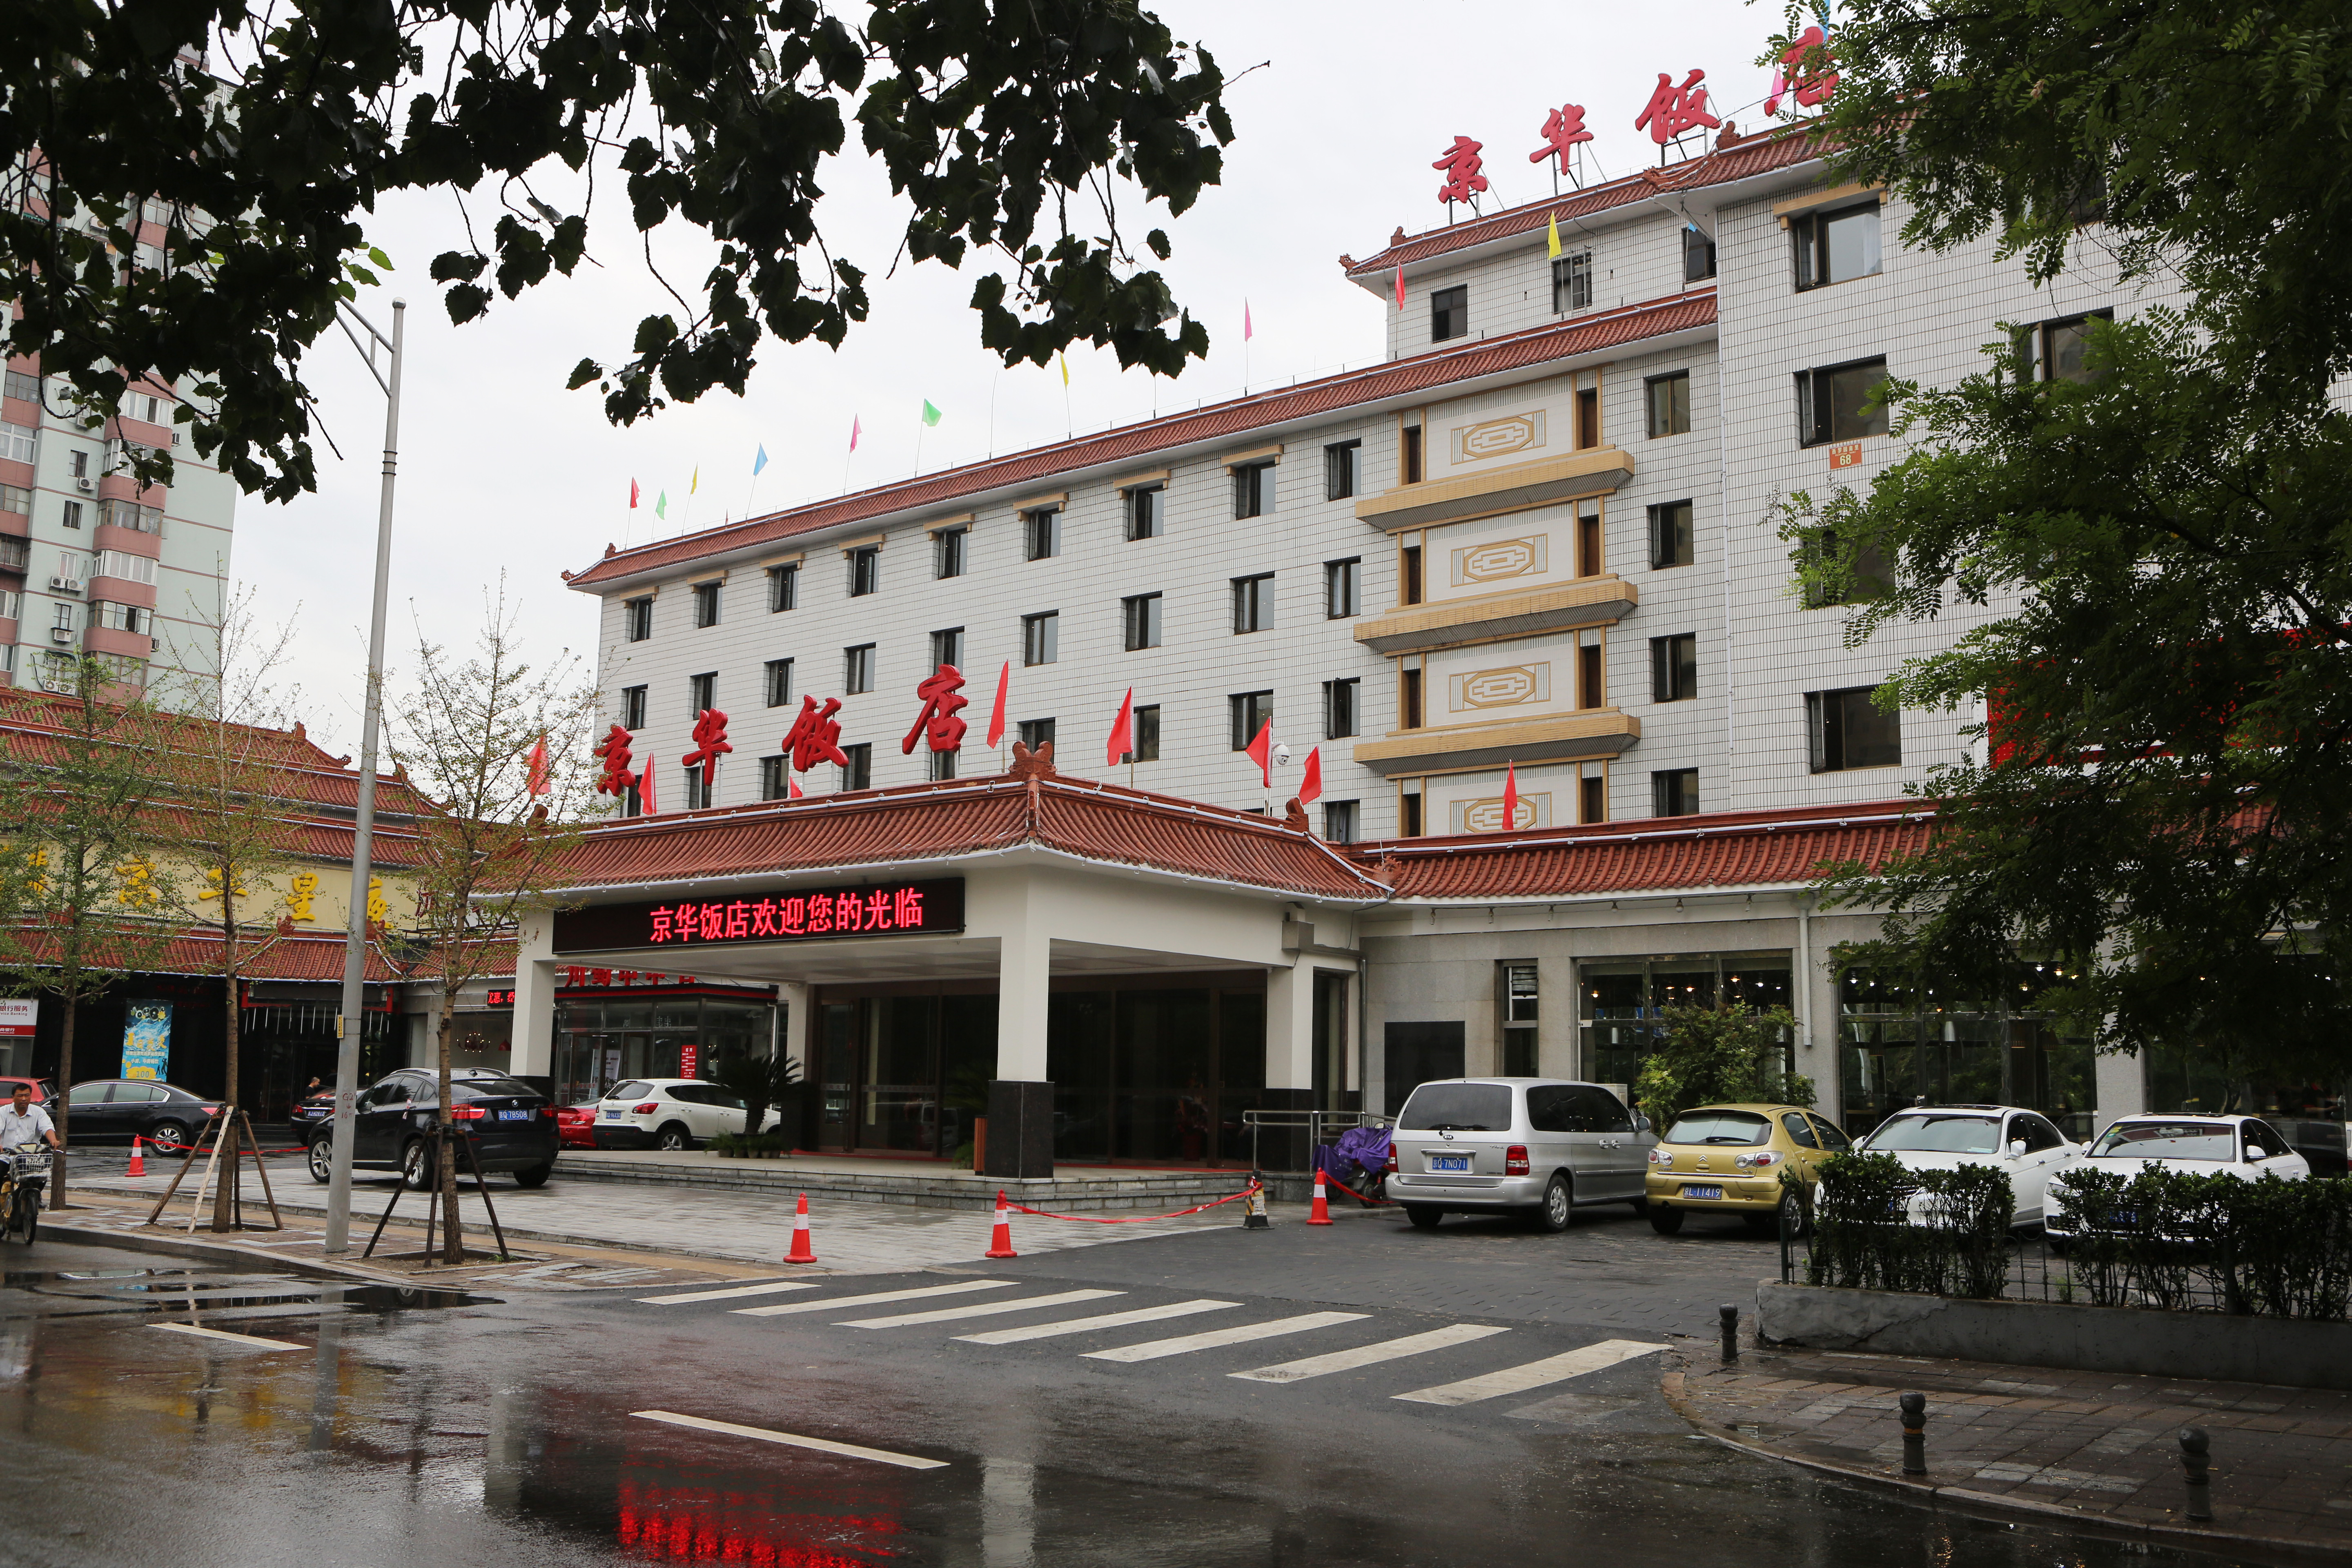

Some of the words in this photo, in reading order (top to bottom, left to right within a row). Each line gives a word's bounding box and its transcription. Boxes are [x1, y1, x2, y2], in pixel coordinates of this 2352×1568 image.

[1432, 26, 1840, 204] 京华饭店
[1840, 454, 1851, 465] 68
[594, 664, 968, 797] 京华饭店
[650, 888, 923, 942] 京华饭店欢迎您的光临
